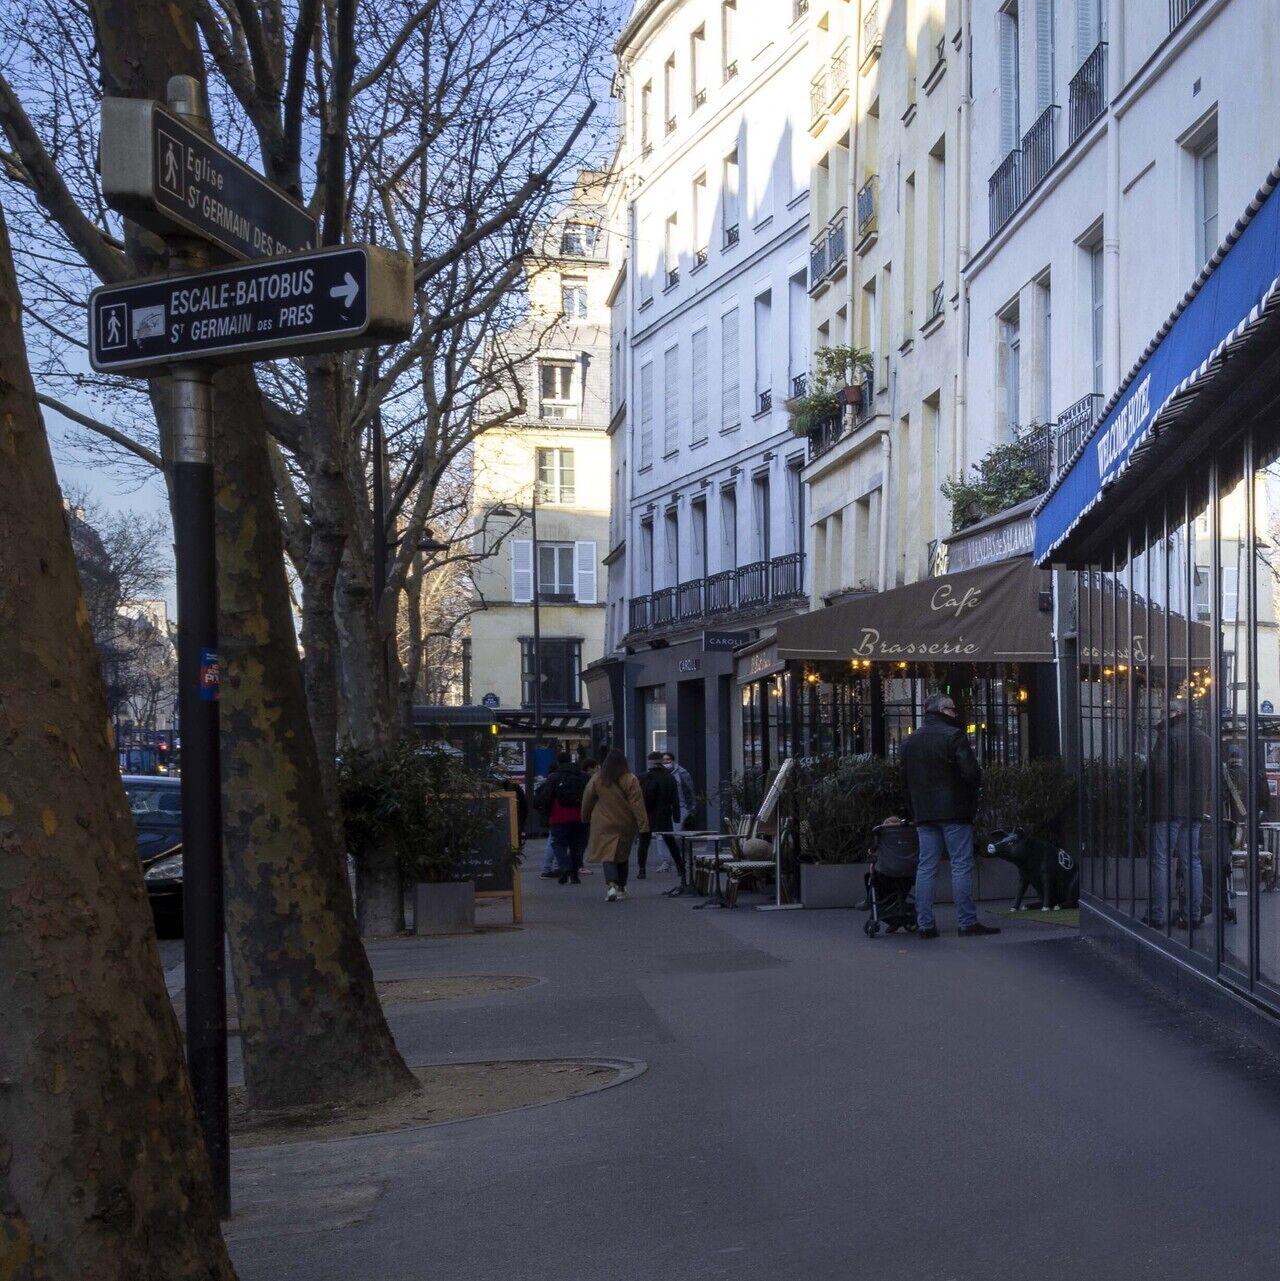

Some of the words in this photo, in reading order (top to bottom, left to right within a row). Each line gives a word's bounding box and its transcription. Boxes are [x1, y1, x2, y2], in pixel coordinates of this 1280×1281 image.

[187, 146, 224, 191] Eglise
[202, 195, 251, 243] GERMAIN
[253, 226, 274, 257] DES
[170, 268, 314, 316] ESCALE-BATOBUS
[191, 313, 251, 341] GERMAIN
[257, 318, 273, 332] DES
[279, 304, 314, 329] PRES
[1097, 405, 1128, 480] WELCOME
[1128, 373, 1152, 438] HOTEL
[930, 584, 982, 617] Café
[852, 627, 980, 656] Brasserie
